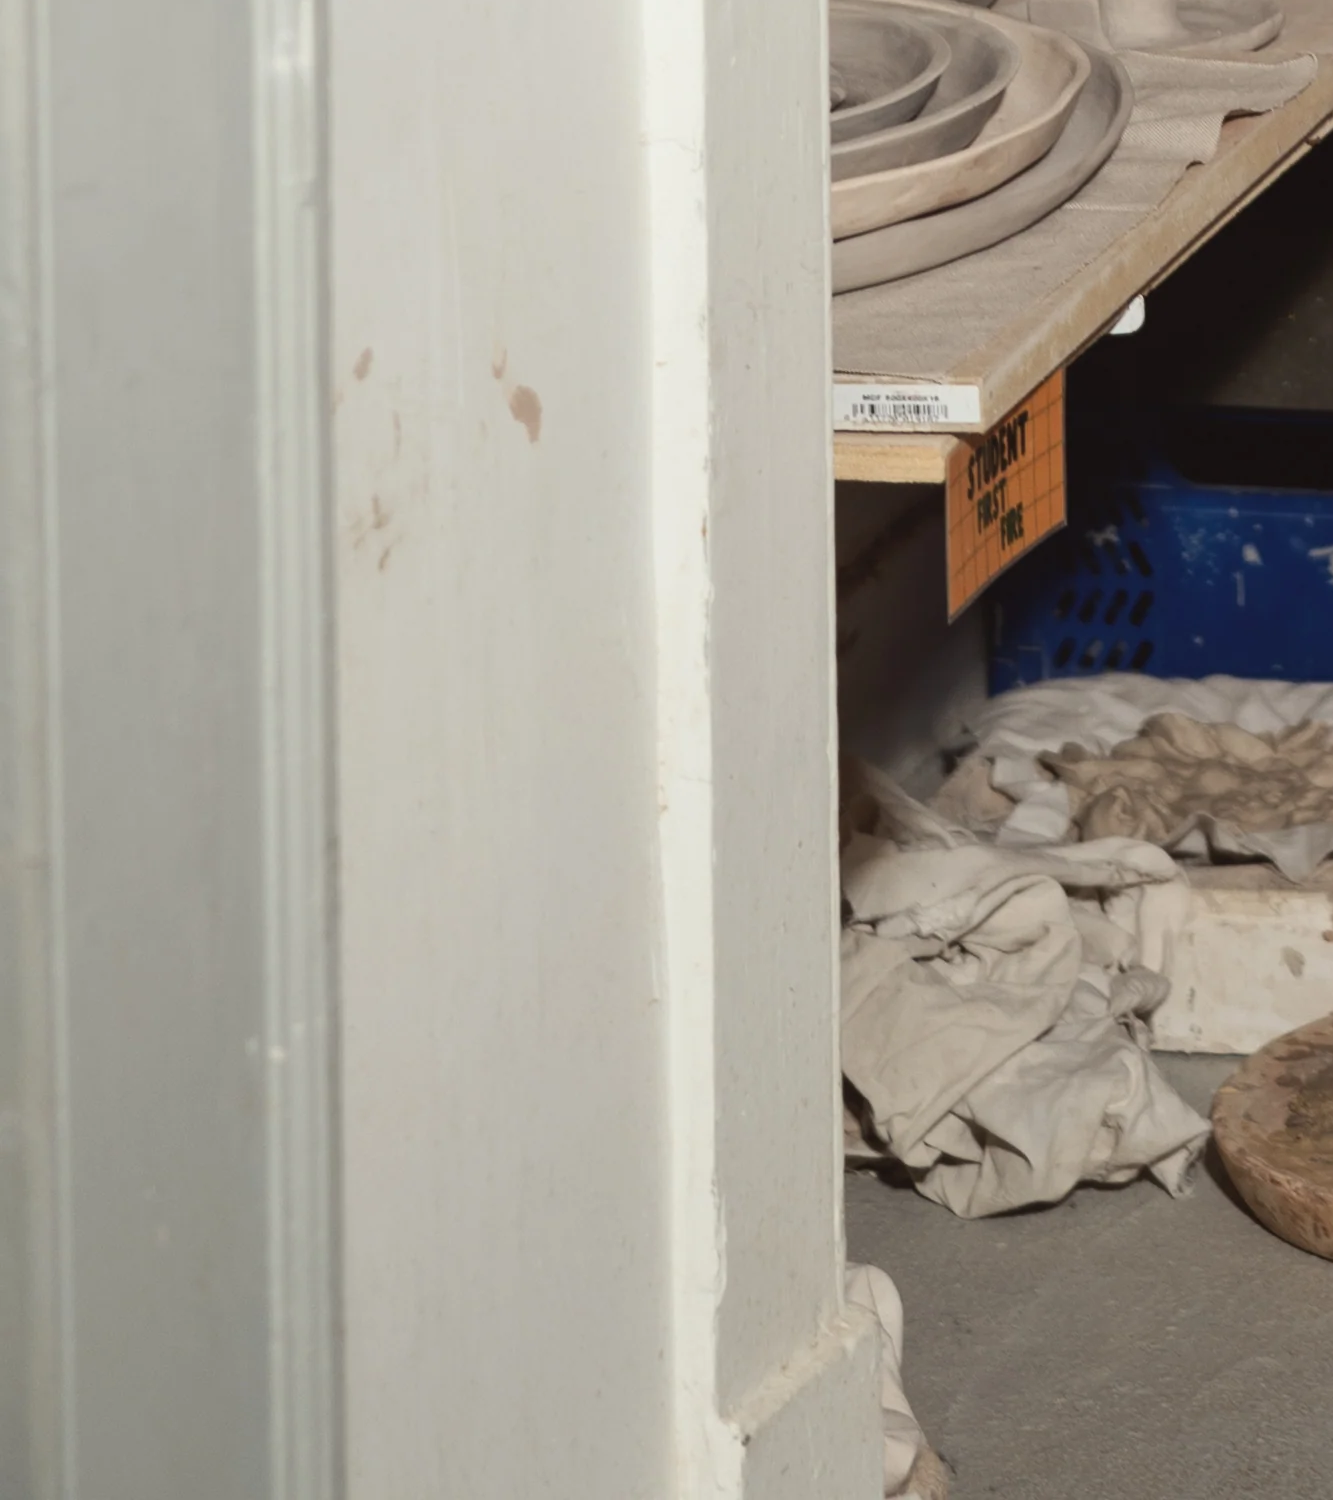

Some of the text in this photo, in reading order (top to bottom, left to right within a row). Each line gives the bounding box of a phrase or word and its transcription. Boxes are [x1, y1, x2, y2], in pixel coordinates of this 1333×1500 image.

[966, 409, 1029, 502] STUDENT
[976, 476, 1007, 535] FIRST
[1000, 501, 1024, 551] FIRE
